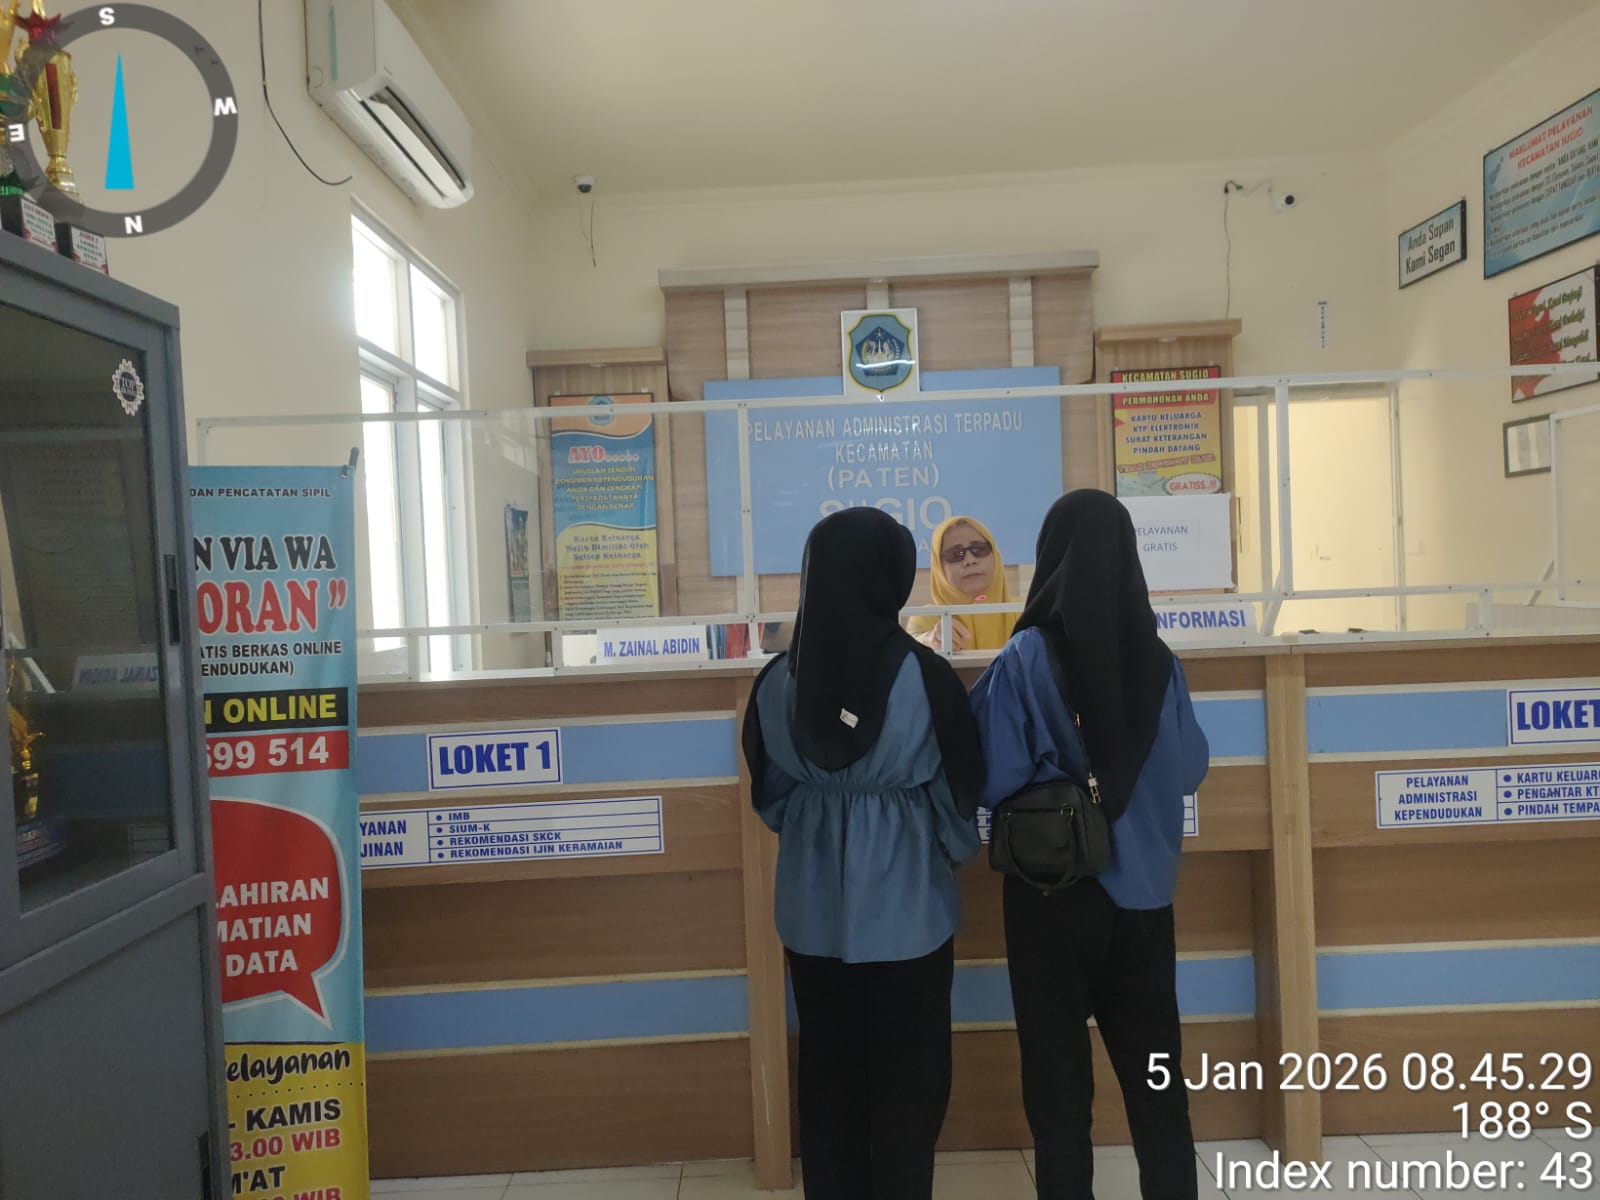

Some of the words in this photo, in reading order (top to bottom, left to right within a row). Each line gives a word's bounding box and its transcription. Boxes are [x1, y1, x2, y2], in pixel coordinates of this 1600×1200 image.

[1408, 231, 1427, 251] Anda
[1428, 217, 1455, 243] Sopan
[1406, 251, 1426, 274] Kami
[1427, 240, 1455, 263] Segan
[1122, 370, 1177, 383] KECAMATAN
[1180, 369, 1209, 380] SUGIO
[1122, 394, 1183, 405] PERMOHONAN
[1185, 393, 1209, 402] ANDA
[843, 413, 948, 438] ADMINISTRASI
[954, 411, 1022, 432] TERPADU
[1131, 413, 1157, 422] KARTU
[1160, 411, 1202, 420] KELUARGA
[1150, 423, 1199, 431] ELEKTRONIK
[1125, 435, 1151, 444] SURAT
[1153, 432, 1208, 441] KETERANGAN
[835, 440, 934, 463] KECAMATAN
[1133, 446, 1165, 454] PINDAH
[1168, 444, 1201, 452] DATANG
[218, 488, 298, 497] PENCATATAN
[302, 488, 331, 497] SIPIL
[820, 496, 953, 531] SGIO
[219, 536, 278, 571] VIA
[284, 536, 336, 570] WA
[1143, 542, 1178, 552] GRATIS
[232, 643, 288, 658] BERKAS
[293, 641, 342, 656] ONLINE
[603, 641, 617, 657] M.
[619, 639, 659, 656] ZAINAL
[662, 637, 700, 655] ABIDIN
[223, 694, 337, 719] ONLINE
[268, 735, 329, 767] 514
[439, 742, 529, 775] LOKET
[536, 741, 551, 770] 1
[1406, 775, 1469, 788] PELAYANAN
[1517, 771, 1553, 783] KARTU
[1556, 769, 1600, 782] KELUAR
[1398, 790, 1477, 805] ADMINISTRASI
[1517, 786, 1582, 800] PENGANTAR
[449, 812, 470, 821] IMB
[1394, 806, 1482, 821] KEPENDUDUKAN
[1518, 803, 1559, 816] PINDAH
[449, 823, 490, 834] SIUM-K
[450, 833, 529, 846] REKOMENDASI
[532, 831, 561, 841] SKCK
[450, 845, 530, 858] REKOMENDASI
[532, 844, 556, 854] IJIN
[558, 841, 623, 853] KERAMAIAN
[215, 877, 329, 909] AHIRAN
[226, 949, 298, 977] DATA
[226, 1049, 350, 1085] elayanan
[246, 1099, 341, 1131] KAMIS
[291, 1128, 341, 1152] WIB
